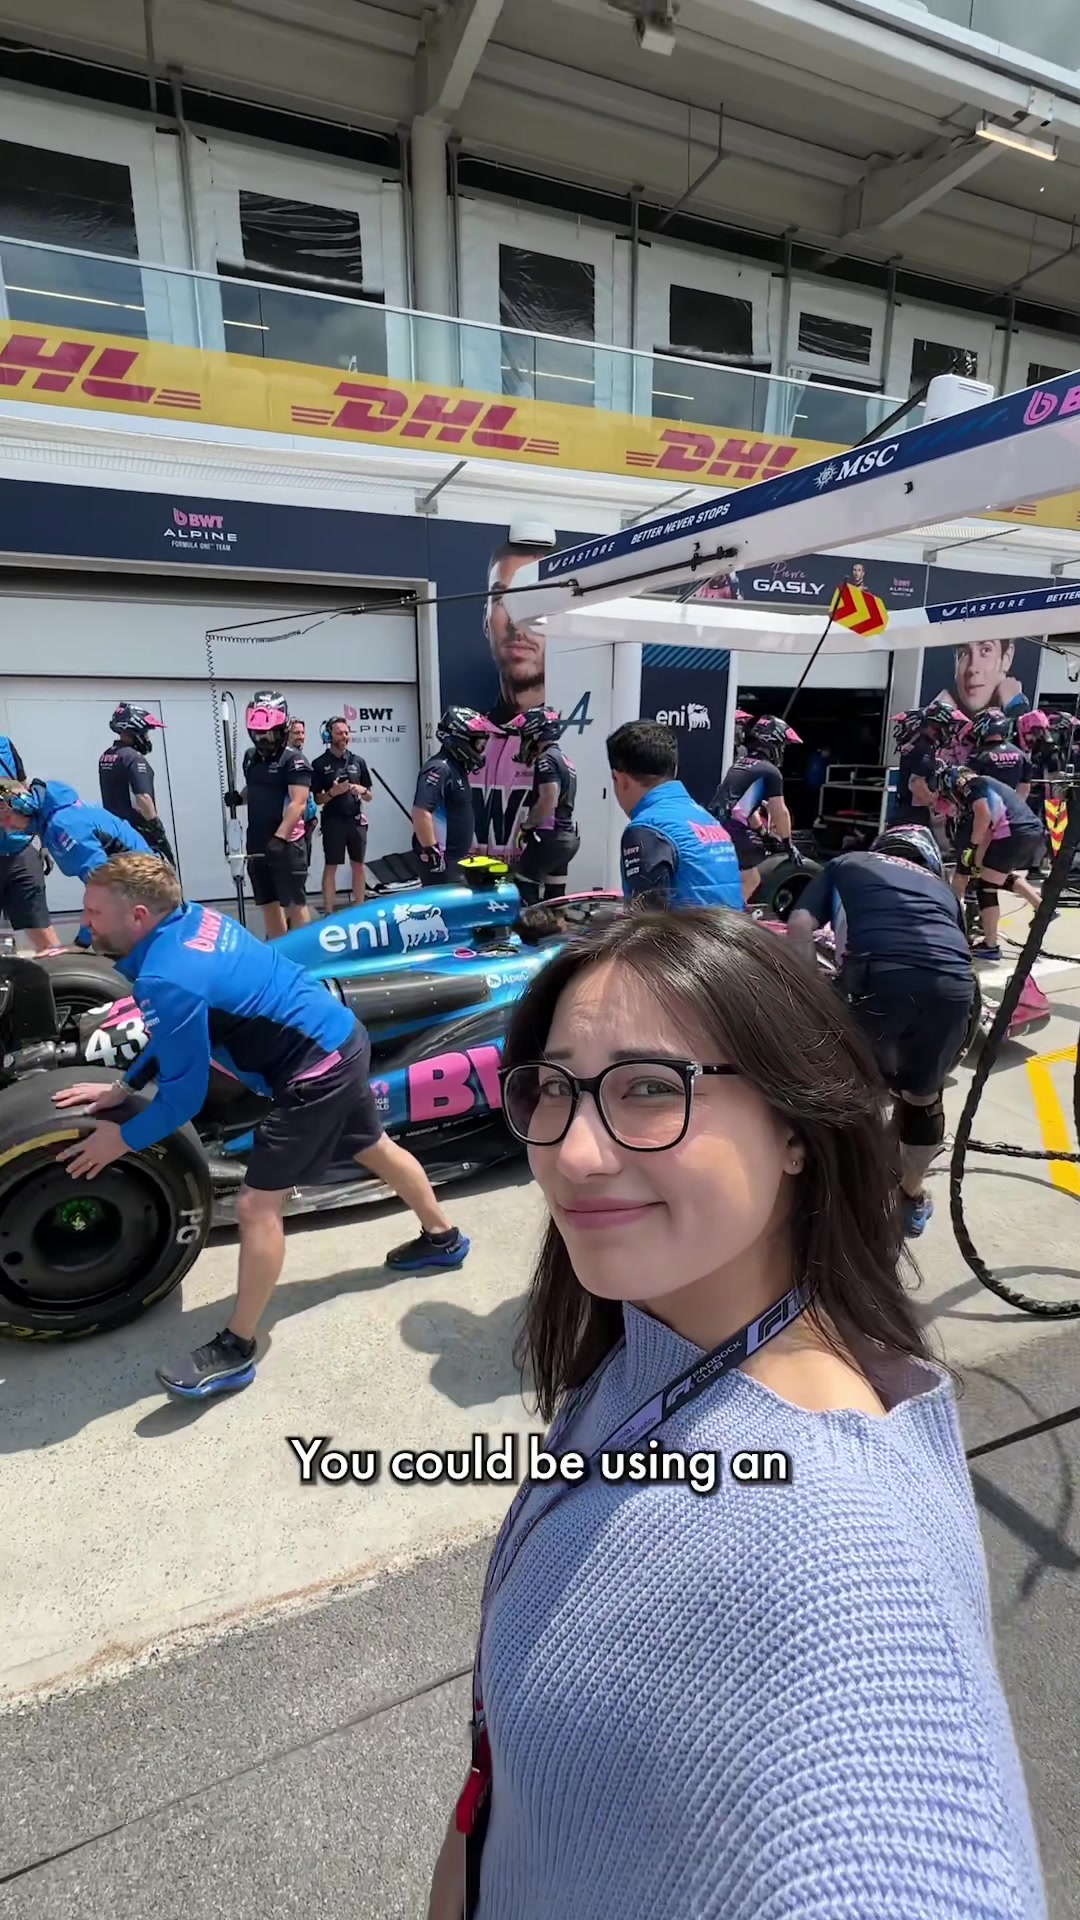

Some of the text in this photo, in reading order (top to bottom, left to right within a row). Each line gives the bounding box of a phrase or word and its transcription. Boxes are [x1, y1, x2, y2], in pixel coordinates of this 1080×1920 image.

[0, 334, 157, 403] HL
[331, 382, 527, 451] DHL
[835, 443, 900, 481] MSC
[188, 513, 223, 528] BWT
[630, 503, 731, 545] BETTER NEVER STOPS
[163, 528, 238, 542] ALPINE
[171, 540, 198, 549] FORMULA
[561, 541, 616, 567] CASTORE
[752, 579, 825, 595] GASLY
[960, 599, 1025, 614] CASTORE
[359, 708, 393, 721] BWT
[655, 704, 686, 727] eni
[348, 725, 407, 733] LPINE
[319, 909, 390, 953] eni
[85, 1017, 149, 1067] 43
[691, 1340, 743, 1379] PADDOCK
[695, 1360, 724, 1384] CLUB
